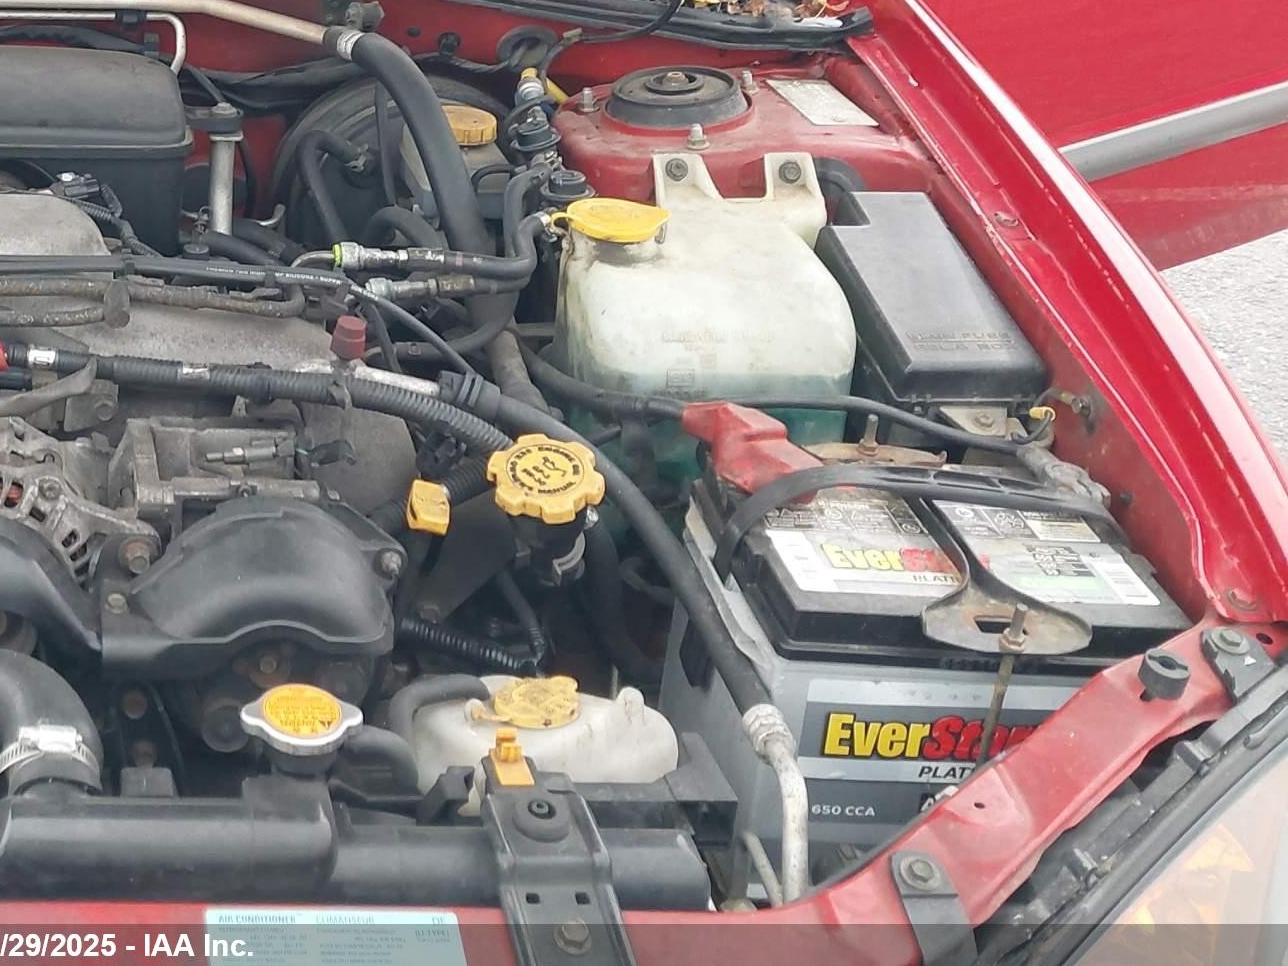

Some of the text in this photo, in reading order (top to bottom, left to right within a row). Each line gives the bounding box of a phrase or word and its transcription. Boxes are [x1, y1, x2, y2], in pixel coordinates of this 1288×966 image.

[811, 804, 876, 817] 650 CCA
[218, 914, 297, 924] AIR CONDITIONER
